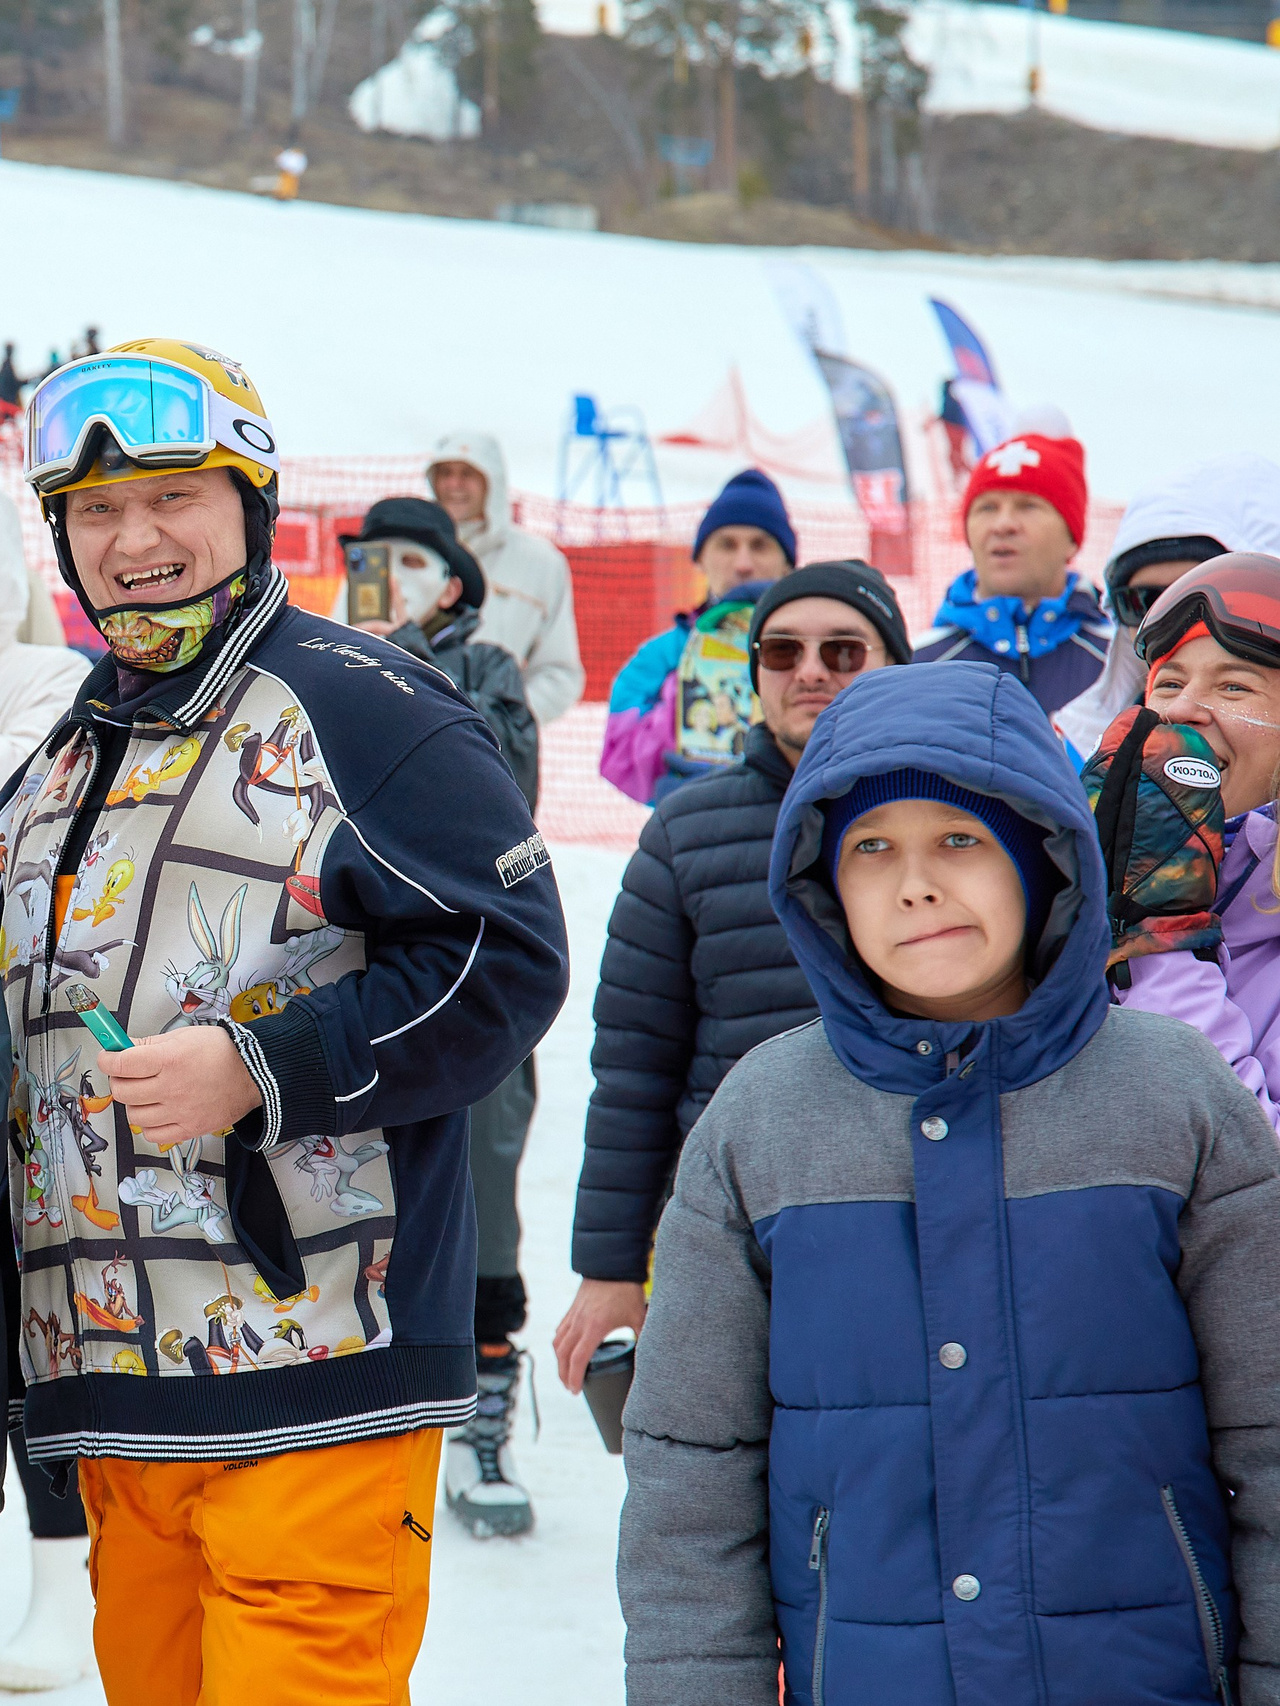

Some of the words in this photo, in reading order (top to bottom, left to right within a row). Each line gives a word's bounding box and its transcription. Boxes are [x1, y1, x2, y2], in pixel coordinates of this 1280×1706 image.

[81, 362, 113, 373] OAKLEY
[1172, 765, 1216, 781] VOLCOM
[223, 1460, 259, 1471] VOLCOM
